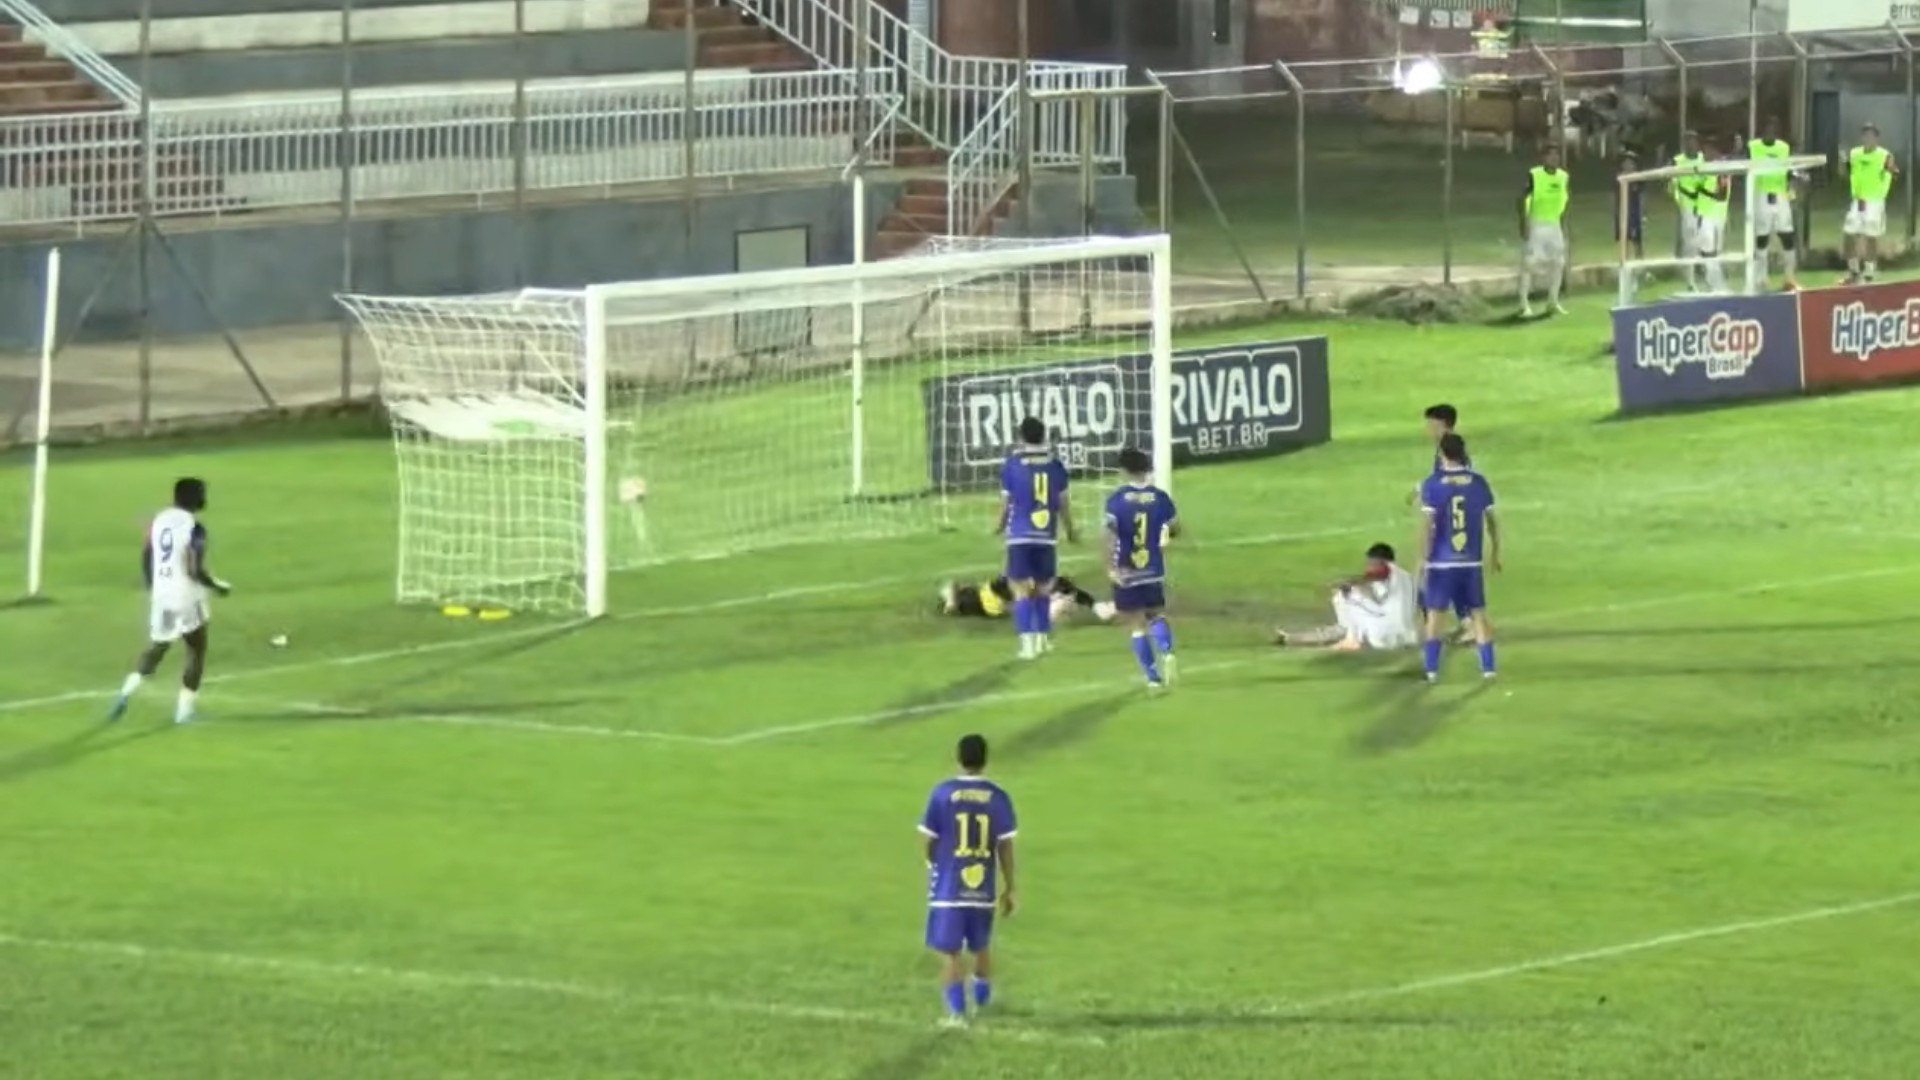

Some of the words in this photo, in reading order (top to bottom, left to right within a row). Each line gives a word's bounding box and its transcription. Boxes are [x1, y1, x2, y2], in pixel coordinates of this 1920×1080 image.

[1638, 312, 1763, 374] HiperCap
[1708, 355, 1745, 375] Brasil
[1170, 362, 1293, 426] RIVALO
[1033, 471, 1049, 506] 4
[1134, 511, 1148, 546] 3
[1451, 495, 1466, 529] 5
[159, 526, 174, 562] 9
[954, 811, 992, 858] 11
